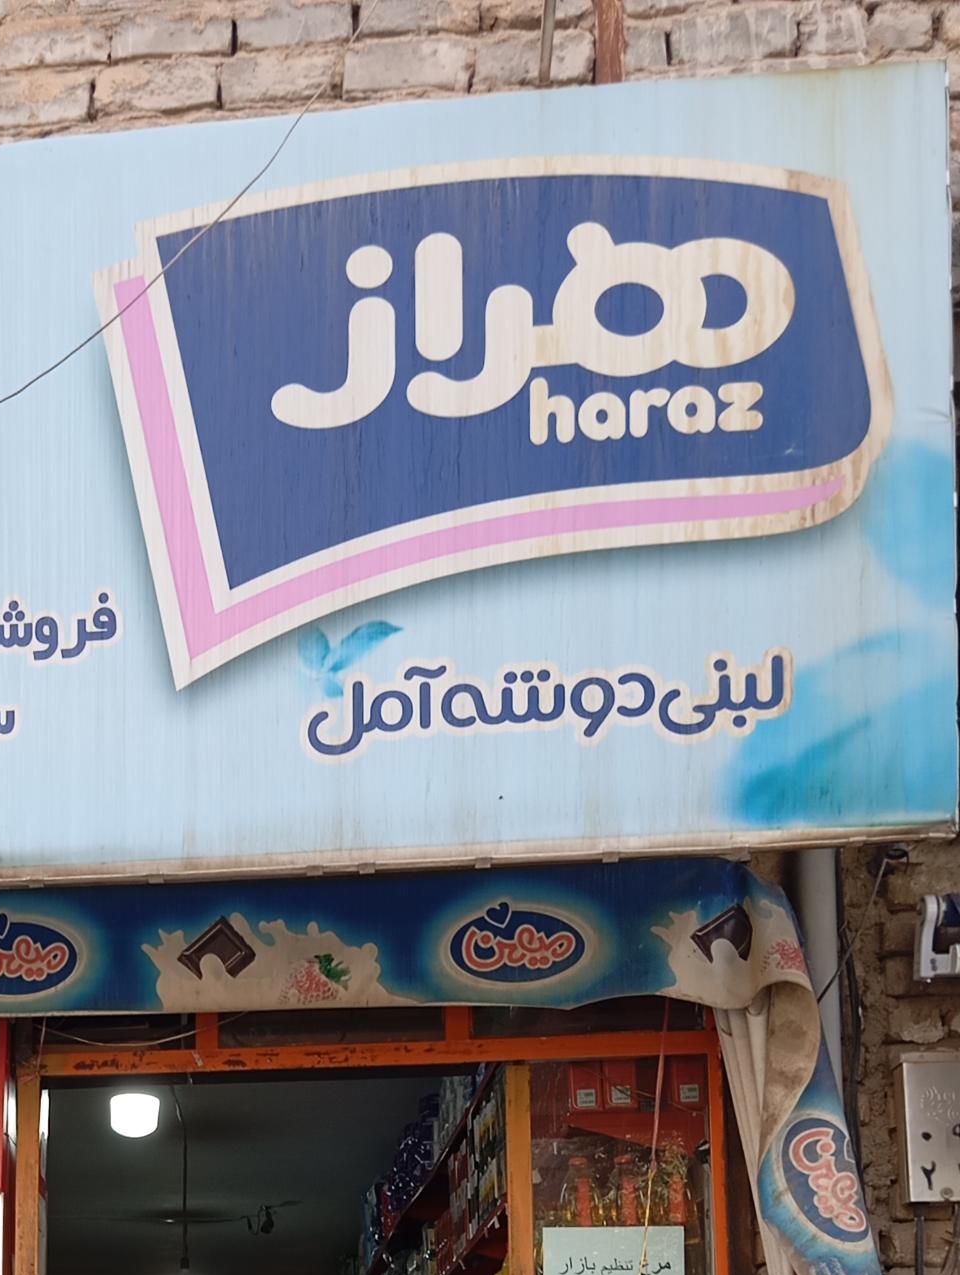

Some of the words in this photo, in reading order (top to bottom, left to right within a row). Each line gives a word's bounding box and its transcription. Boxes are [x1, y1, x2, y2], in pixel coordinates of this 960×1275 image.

[271, 222, 795, 429] هراز
[529, 377, 764, 445] haraz
[307, 664, 447, 756] آمل
[441, 668, 656, 738] دوشه
[659, 655, 784, 736] لبنی
[461, 923, 576, 970] میهن
[558, 1256, 596, 1275] بازار
